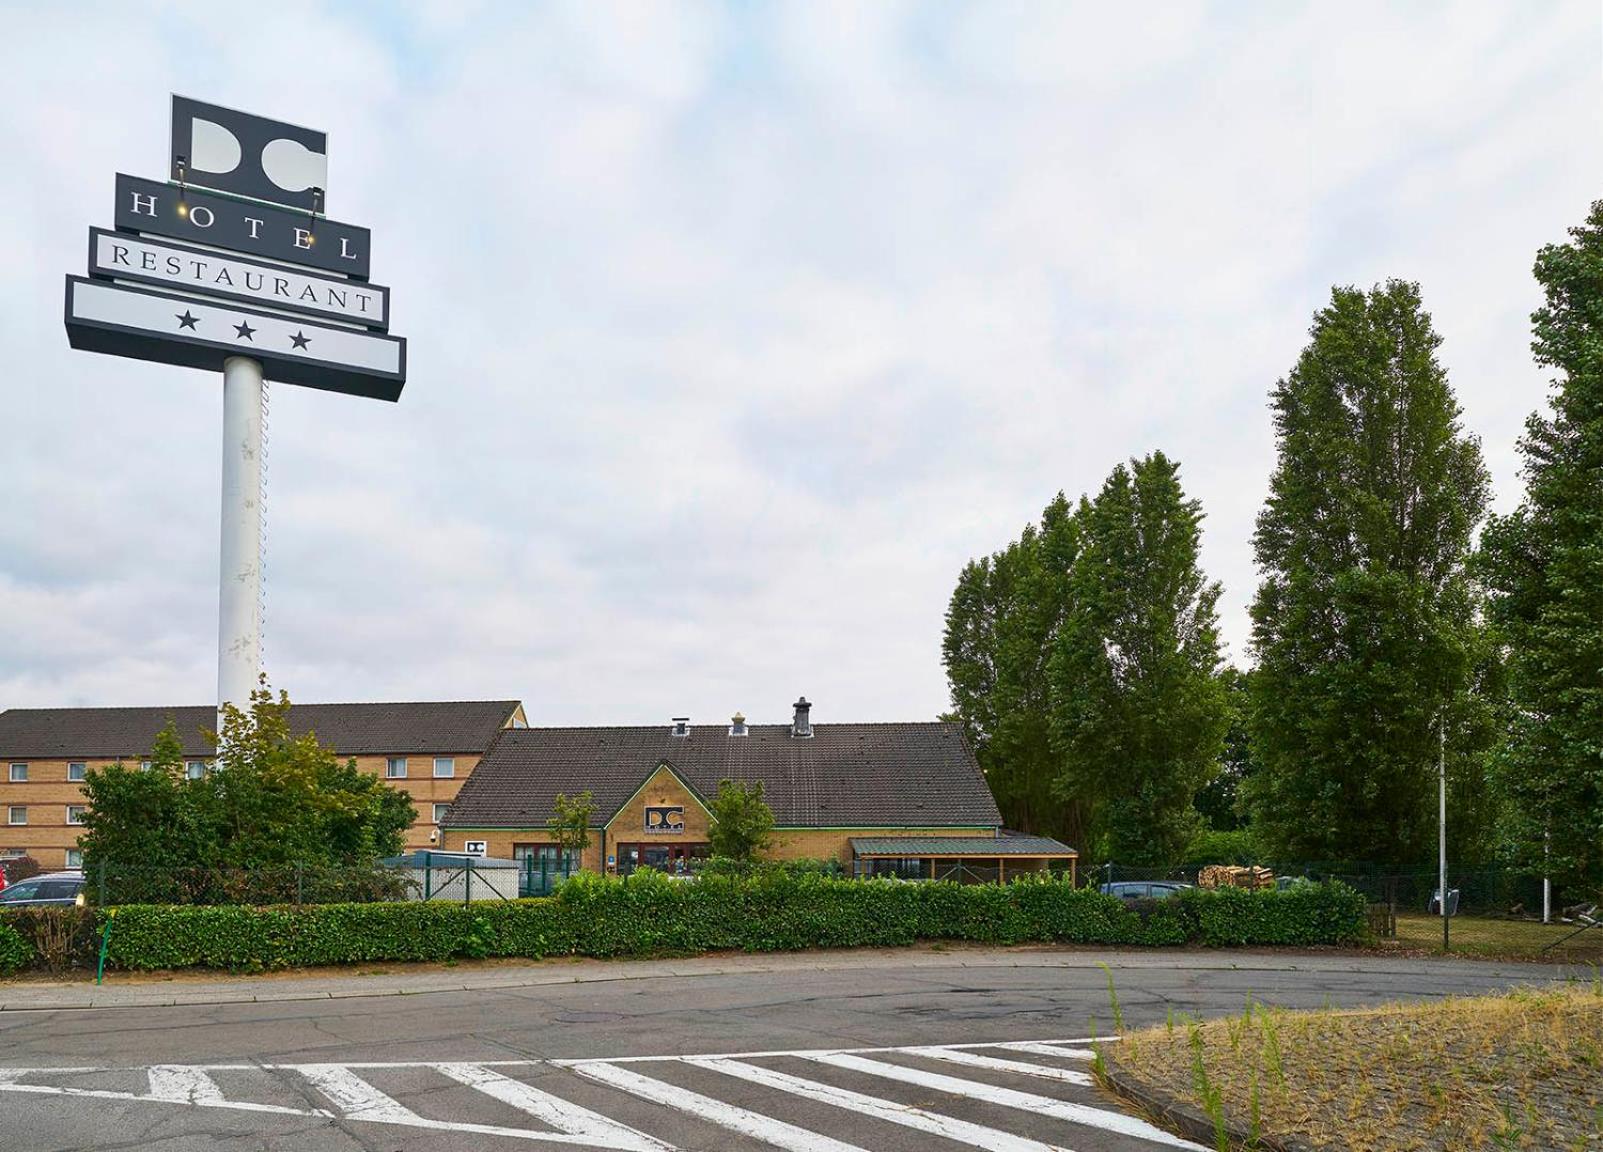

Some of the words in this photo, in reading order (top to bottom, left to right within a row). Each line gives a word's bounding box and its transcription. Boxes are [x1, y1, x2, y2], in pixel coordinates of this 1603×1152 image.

[191, 117, 326, 192] DC
[130, 192, 357, 260] HOTEL
[112, 245, 372, 312] RESTAURANT
[649, 811, 684, 826] DC
